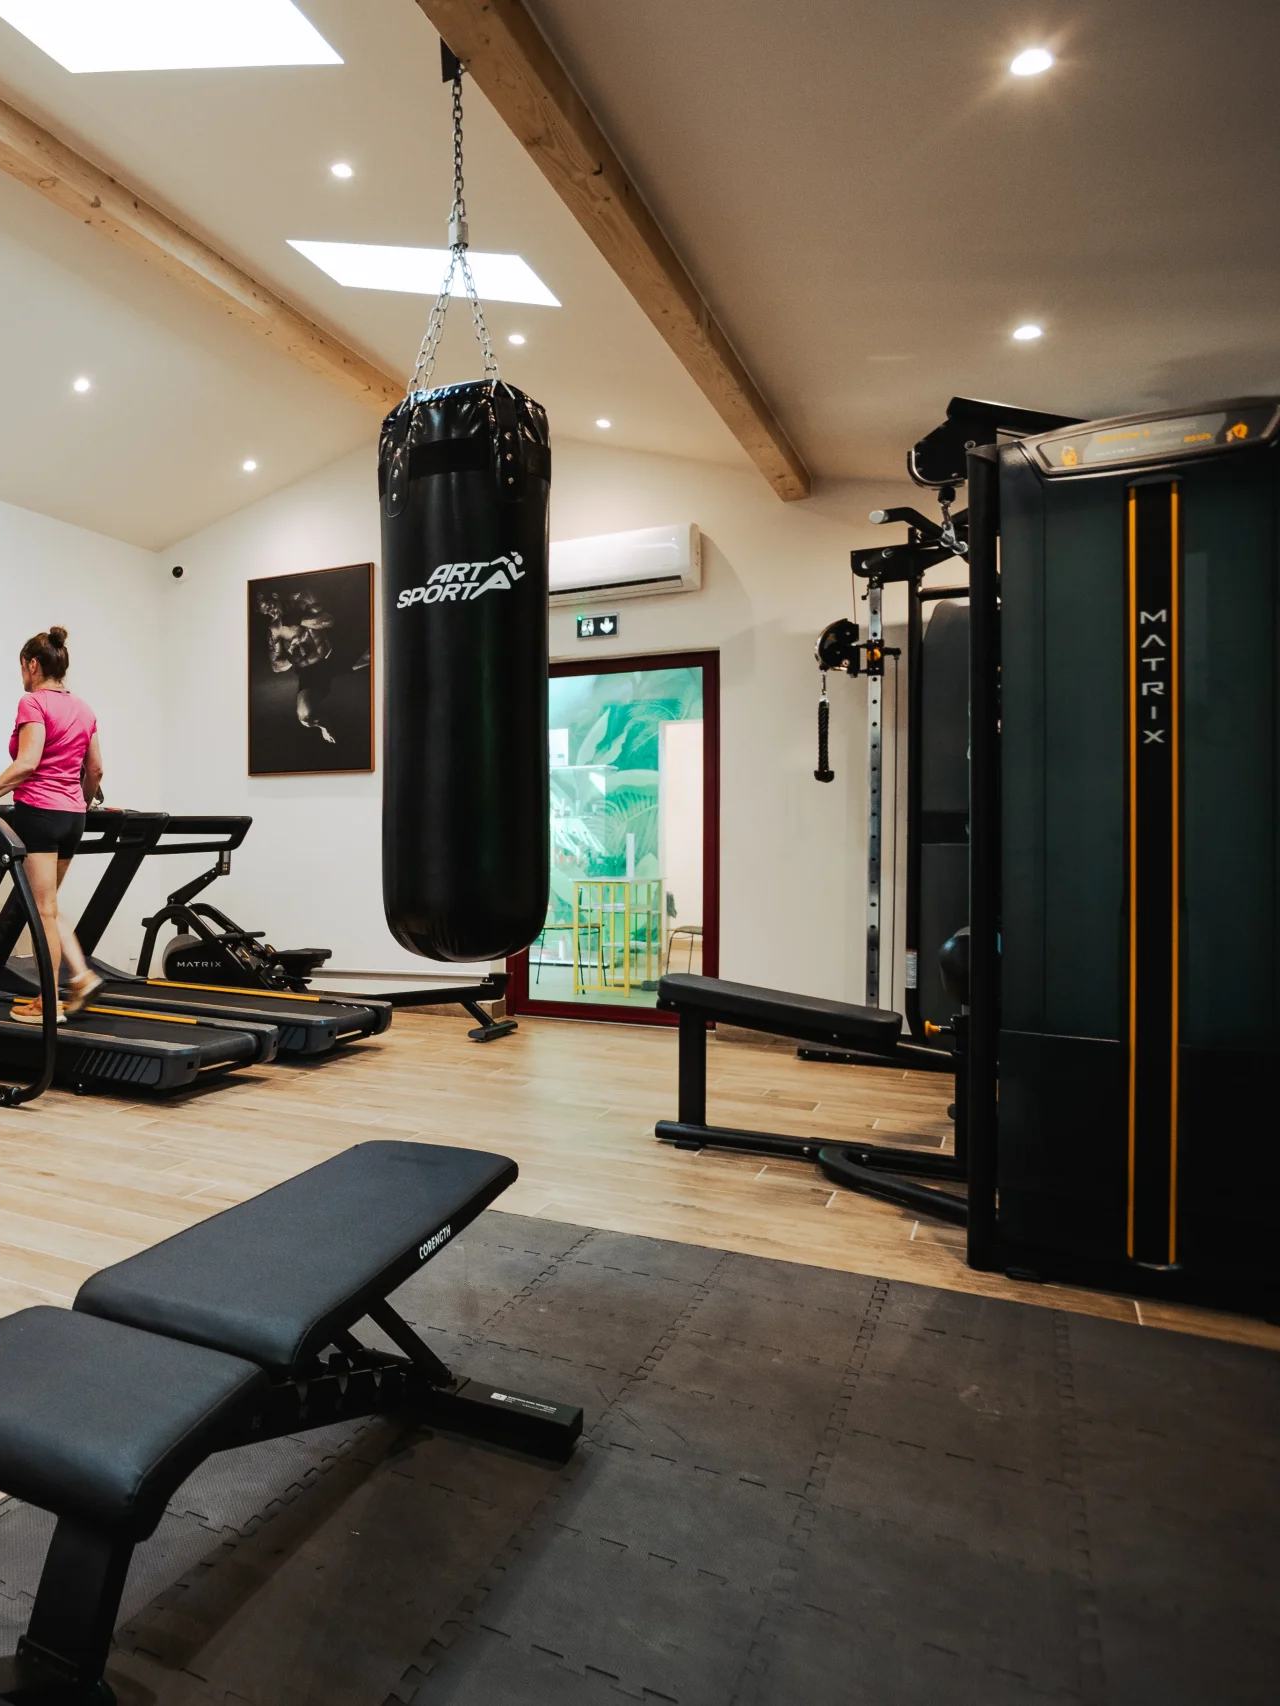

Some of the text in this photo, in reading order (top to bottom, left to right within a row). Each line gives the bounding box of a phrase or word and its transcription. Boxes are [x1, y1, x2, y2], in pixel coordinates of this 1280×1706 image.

[426, 562, 489, 585] ART
[396, 582, 480, 609] SPORT
[1140, 609, 1167, 744] MATRIX
[419, 1224, 451, 1260] CORENGTH
